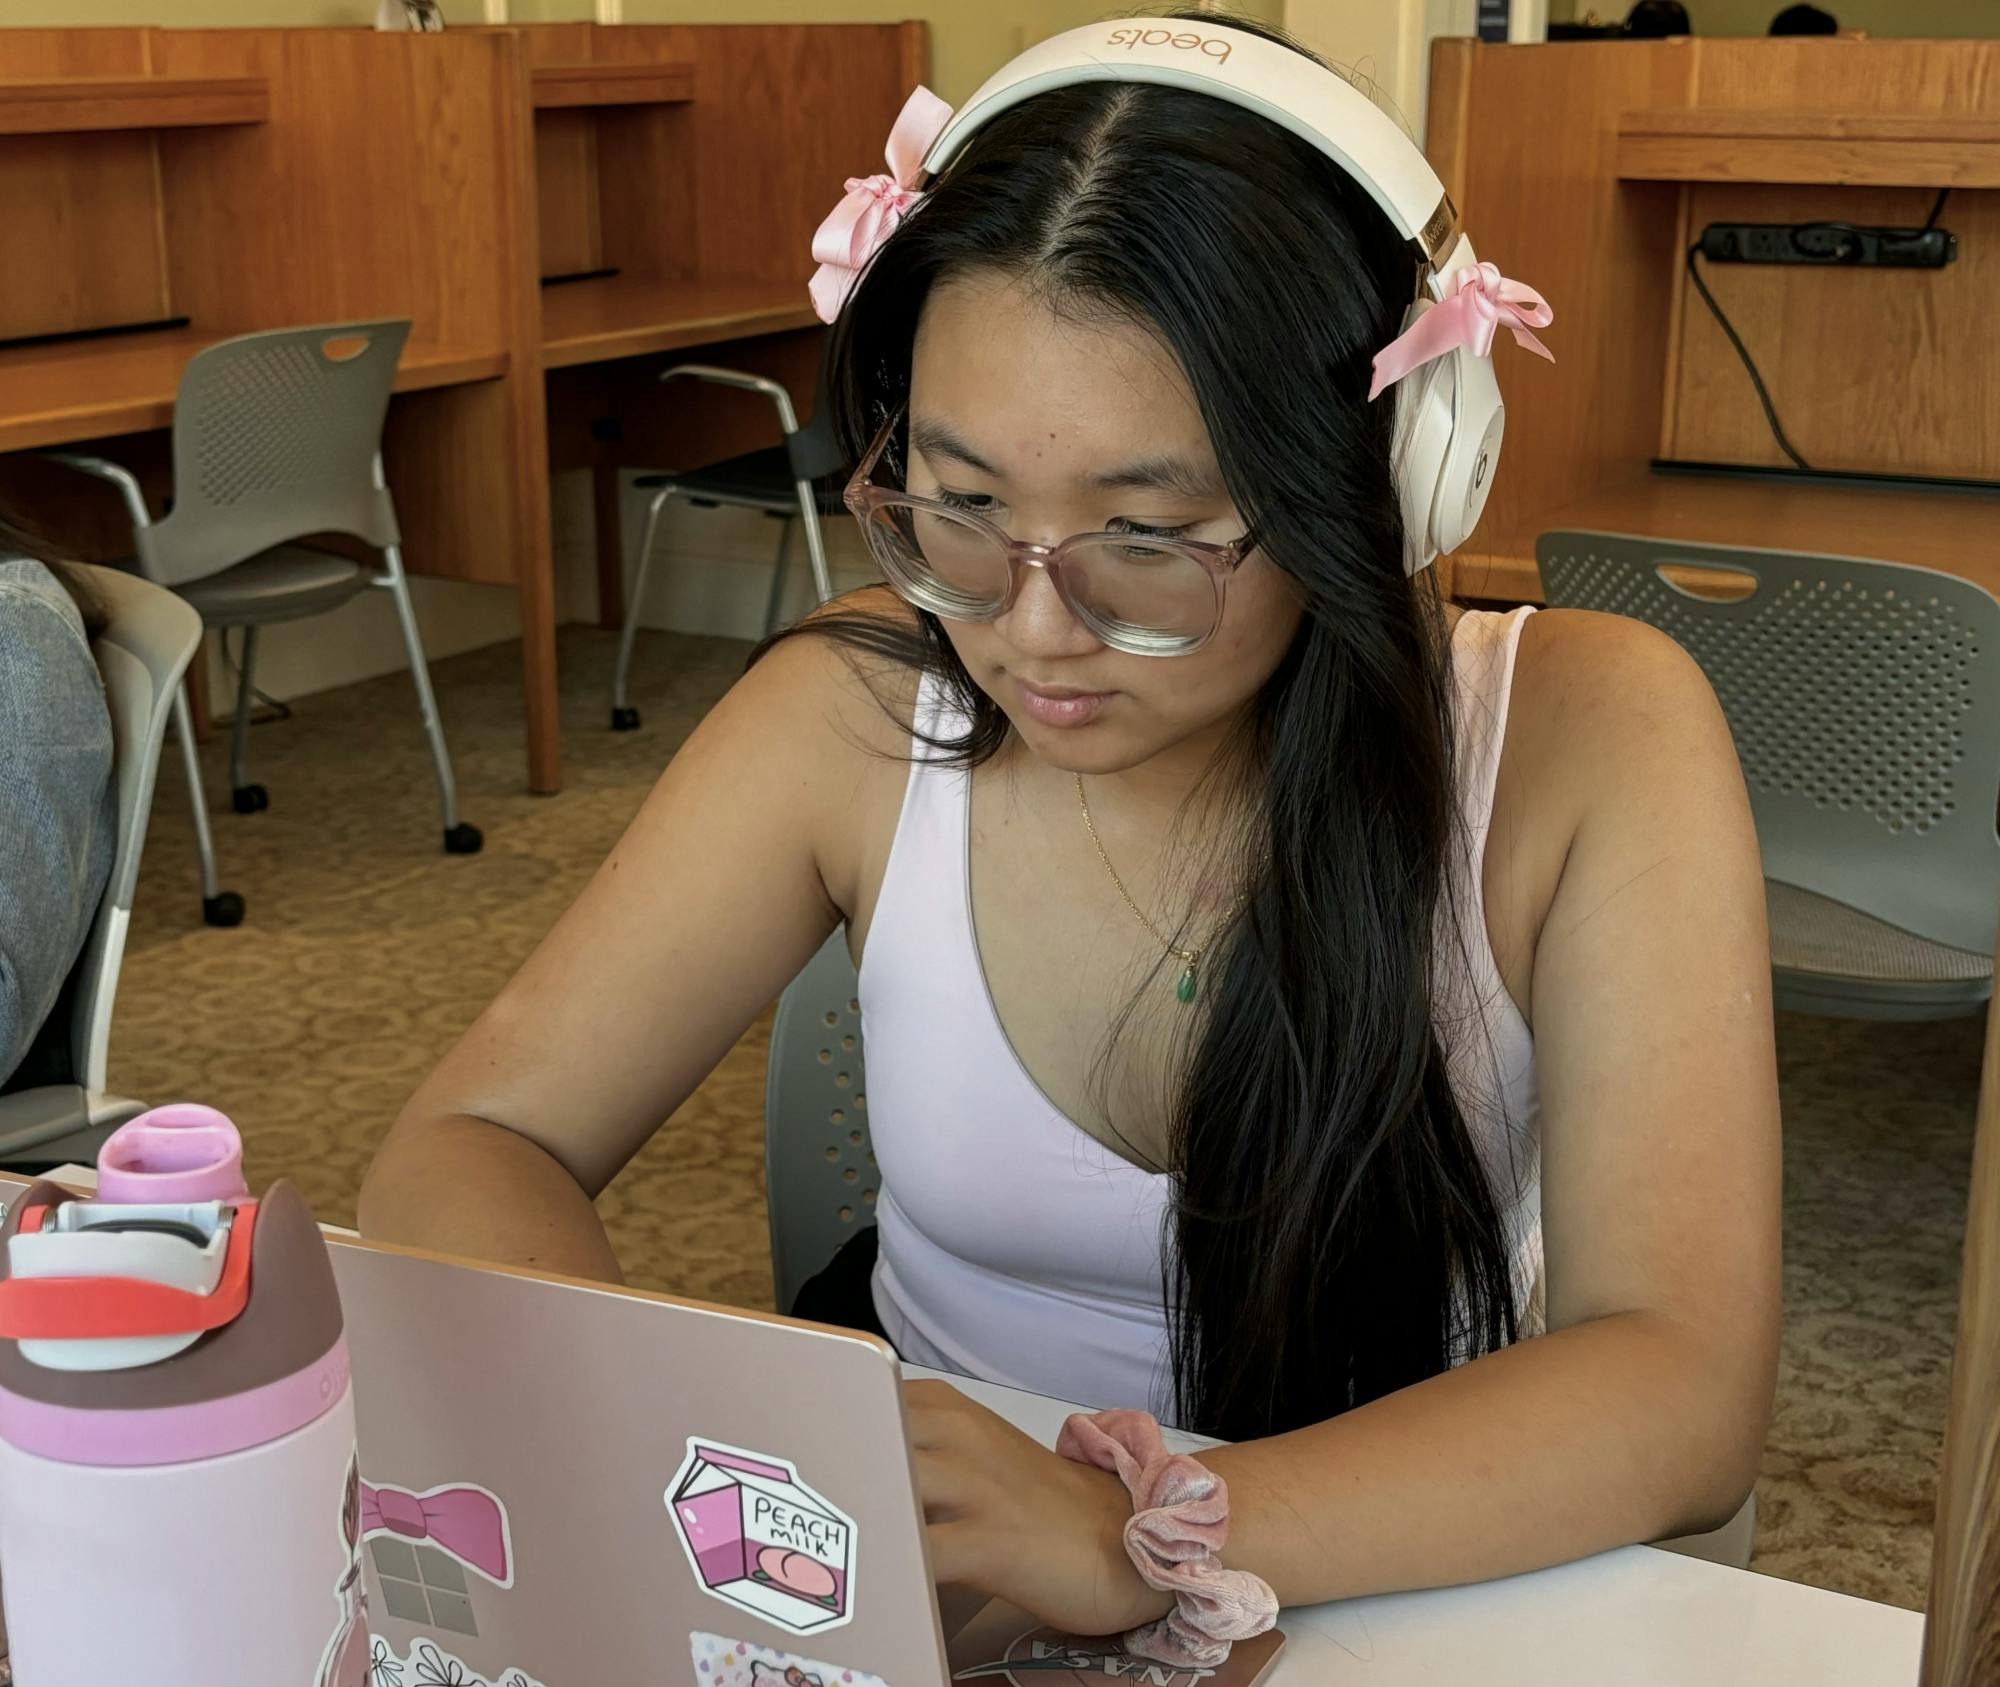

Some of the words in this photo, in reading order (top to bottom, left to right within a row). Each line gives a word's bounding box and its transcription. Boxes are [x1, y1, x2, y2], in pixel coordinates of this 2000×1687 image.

[1107, 28, 1232, 65] beats
[754, 1497, 840, 1546] PEACH
[1031, 1639, 1177, 1687] NASA
